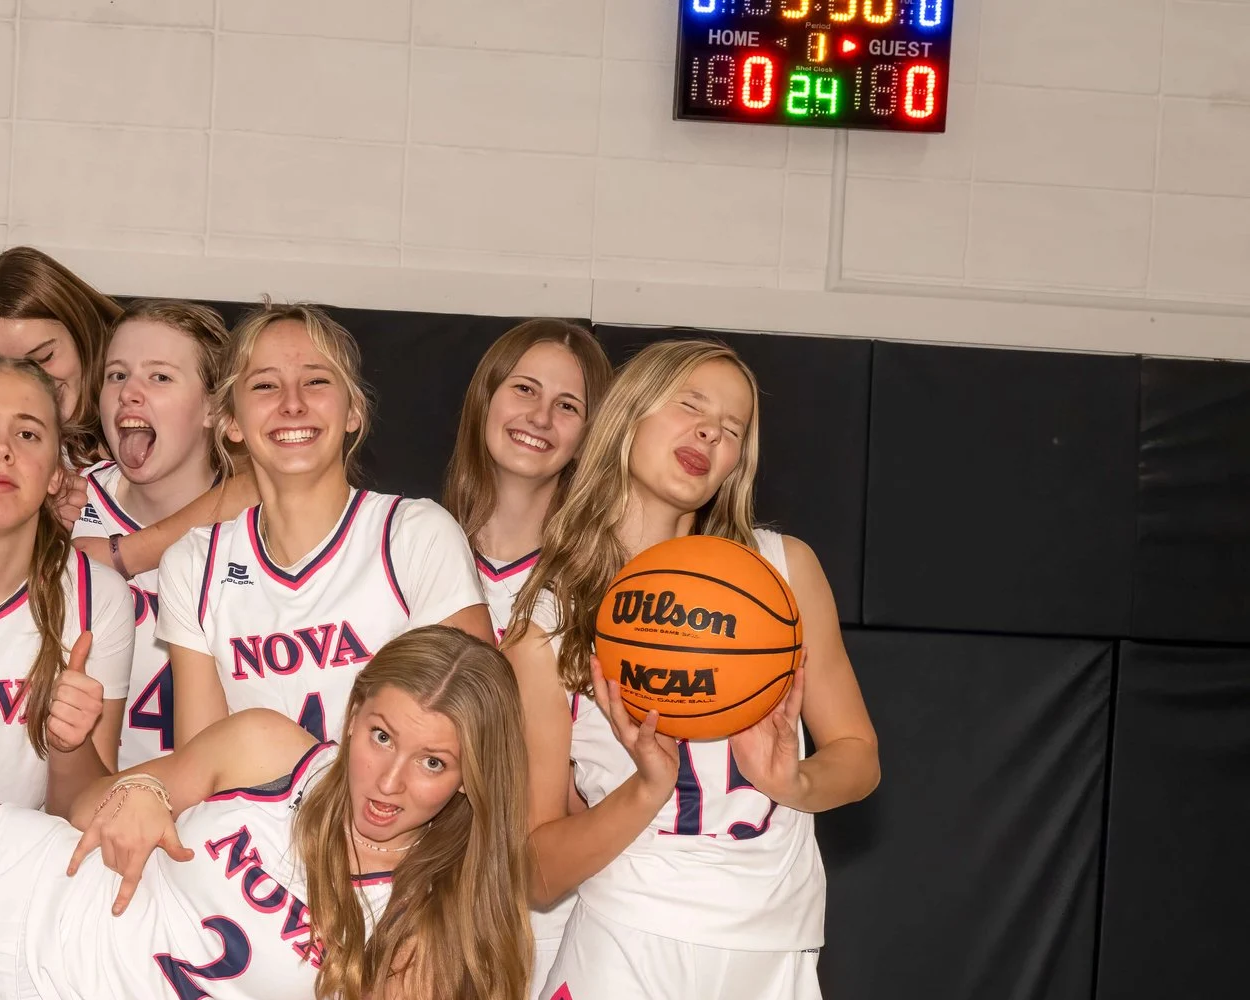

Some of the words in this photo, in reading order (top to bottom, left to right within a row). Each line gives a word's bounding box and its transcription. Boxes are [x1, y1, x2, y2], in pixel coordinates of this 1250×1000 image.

[708, 29, 760, 47] HOME
[805, 21, 831, 30] Period
[868, 39, 933, 58] GUEST
[741, 56, 773, 108] 0
[787, 74, 838, 115] 24
[904, 65, 936, 118] 0
[612, 590, 736, 639] Wilson
[229, 620, 375, 680] NOVA
[620, 659, 717, 697] NCAA
